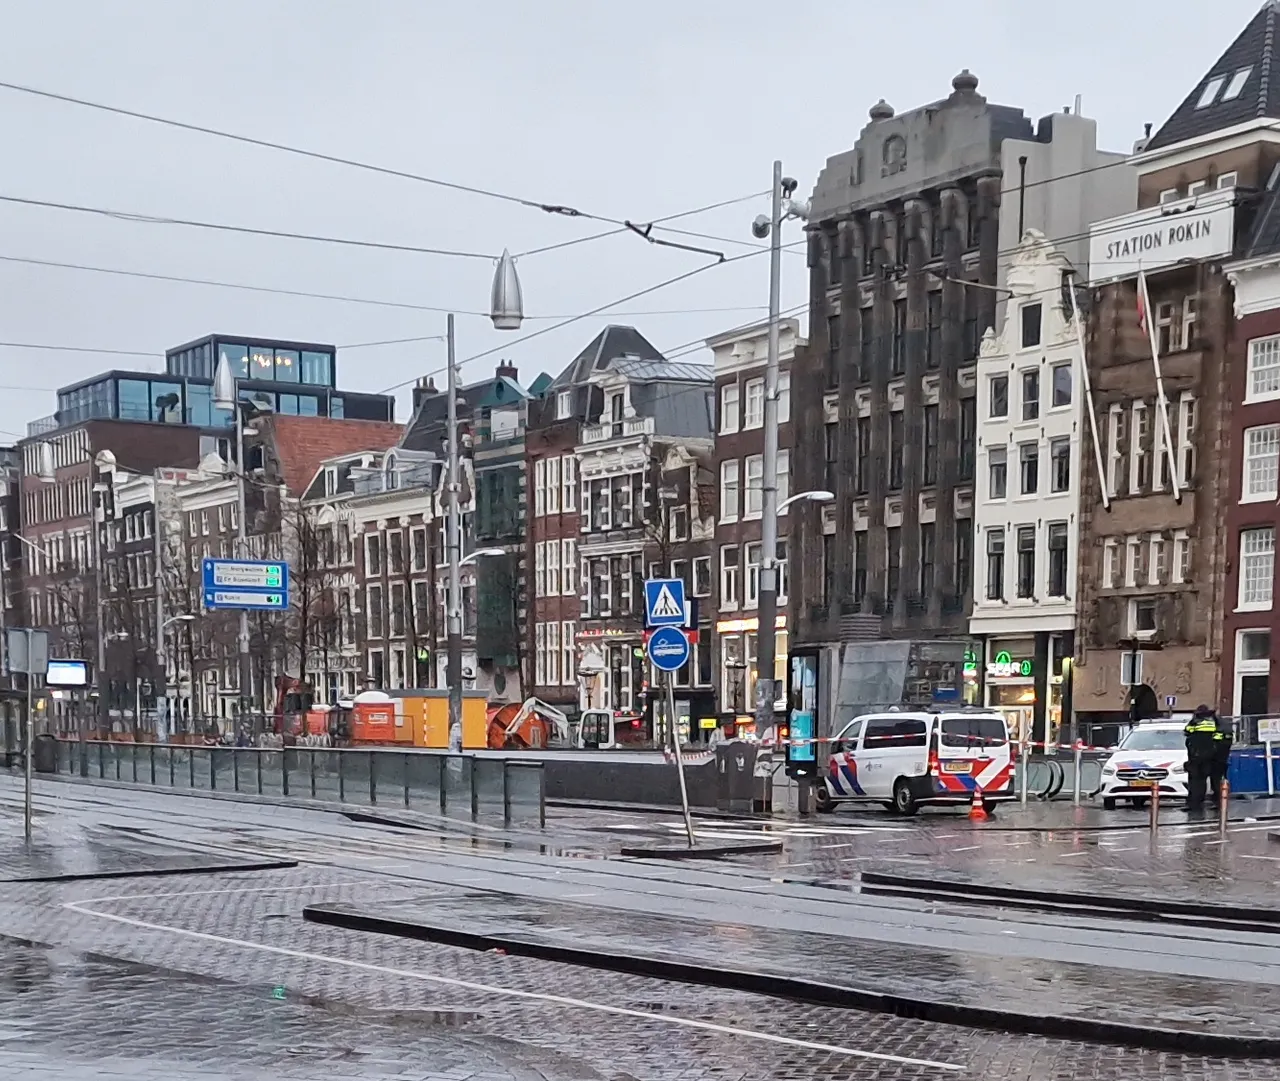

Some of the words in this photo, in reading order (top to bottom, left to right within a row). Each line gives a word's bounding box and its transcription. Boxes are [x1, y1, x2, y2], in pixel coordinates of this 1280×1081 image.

[1106, 230, 1163, 259] STATION
[1169, 219, 1212, 246] ROKIN
[986, 661, 1021, 675] SPAR
